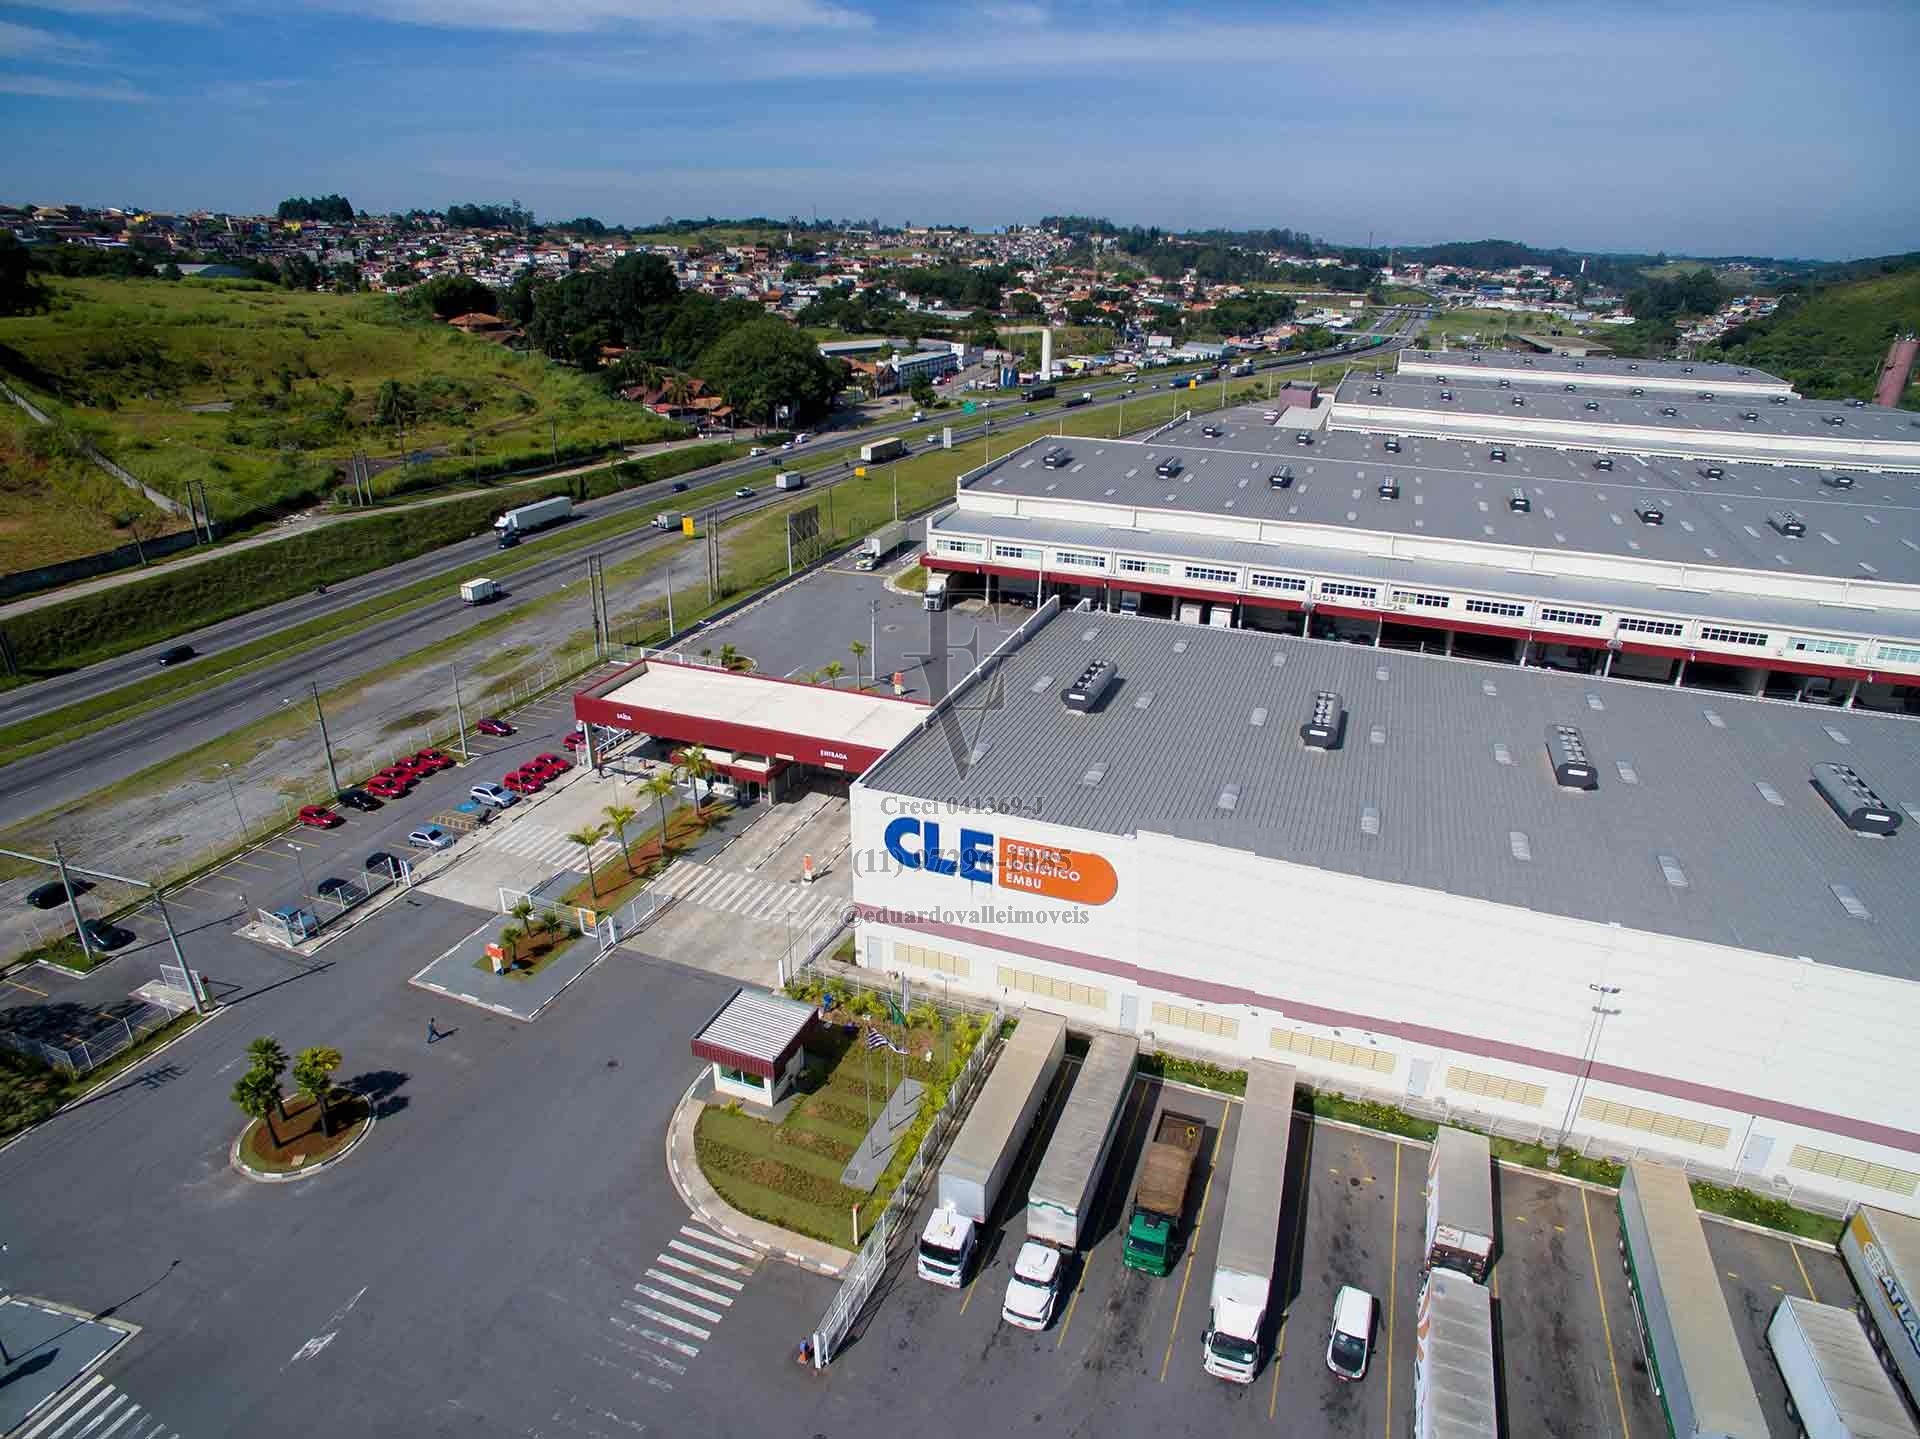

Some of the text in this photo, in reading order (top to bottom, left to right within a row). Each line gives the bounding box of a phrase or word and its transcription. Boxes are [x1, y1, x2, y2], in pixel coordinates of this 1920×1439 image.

[884, 817, 994, 885] CLE
[1007, 844, 1061, 862] CENTRO
[1006, 872, 1042, 889] EMBU
